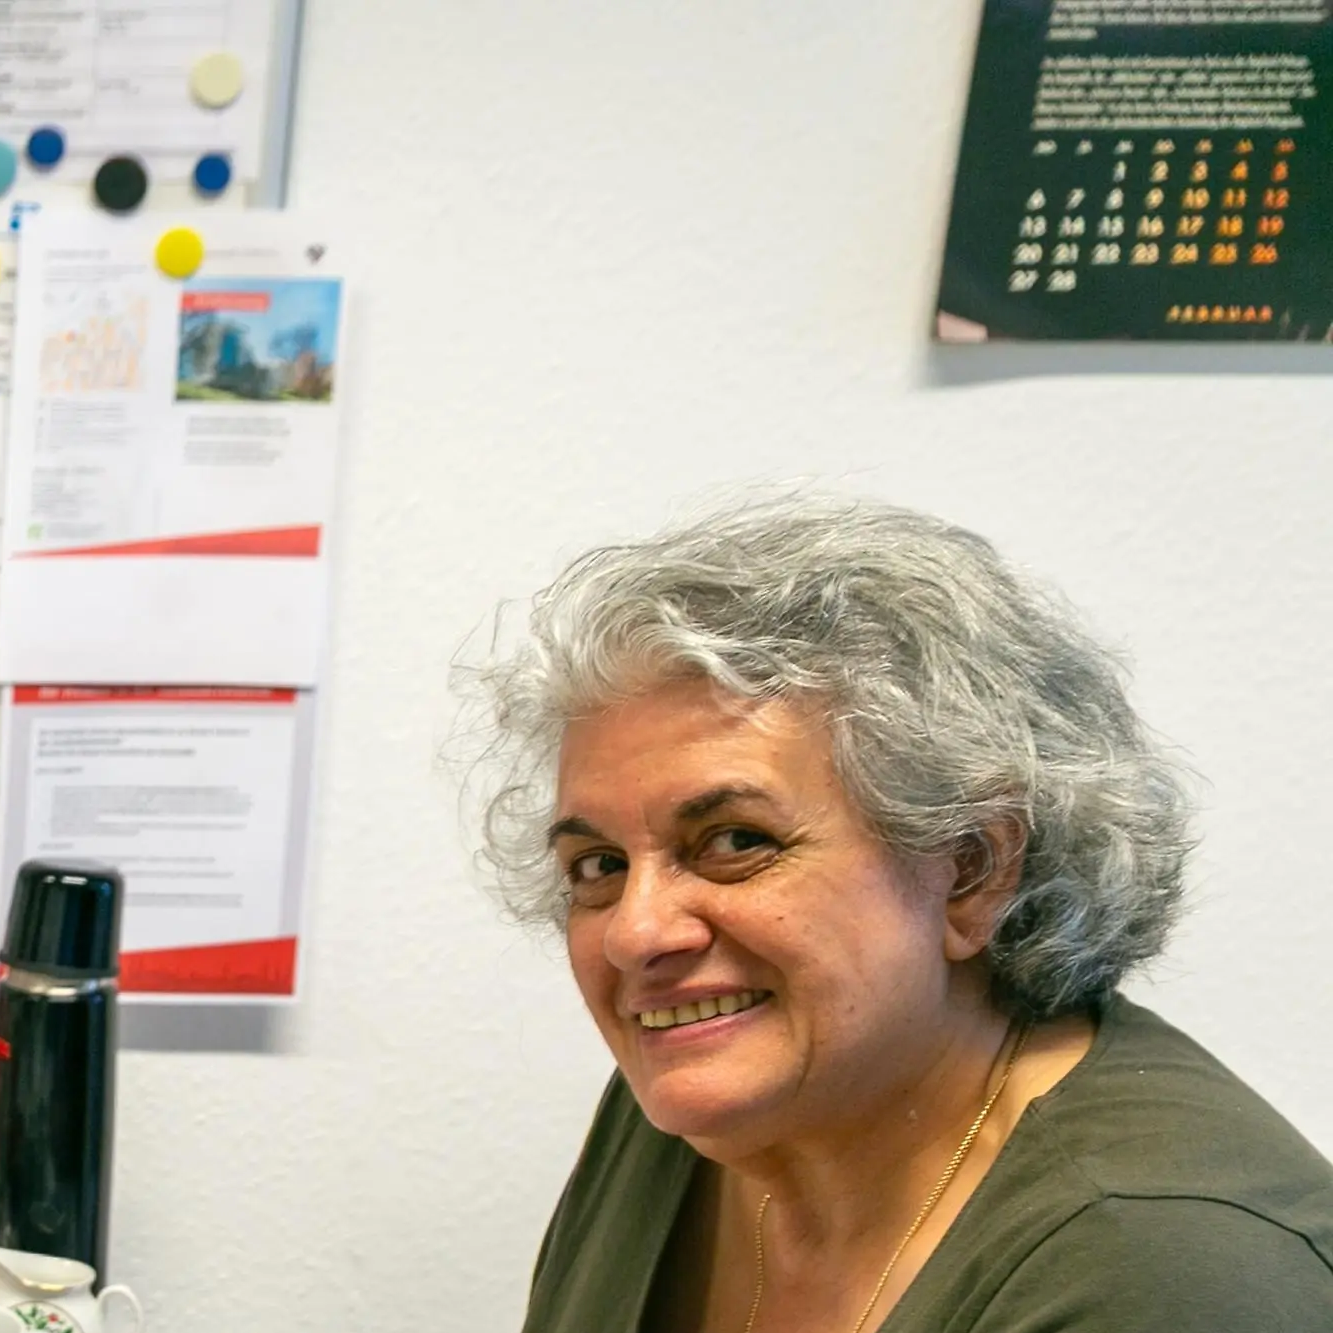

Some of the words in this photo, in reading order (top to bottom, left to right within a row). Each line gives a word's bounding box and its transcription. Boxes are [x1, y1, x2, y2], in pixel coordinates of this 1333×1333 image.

[1150, 160, 1169, 183] 2
[1066, 188, 1085, 210] 7
[1182, 188, 1210, 210] 10
[1221, 188, 1247, 210] 11
[1263, 188, 1290, 210] 12
[1137, 215, 1164, 238] 16
[1177, 215, 1205, 238] 17
[1257, 215, 1284, 238] 19
[1051, 242, 1080, 265] 21
[1091, 242, 1121, 265] 22
[1129, 242, 1160, 265] 23
[1169, 242, 1199, 265] 24
[1008, 269, 1039, 292] 27
